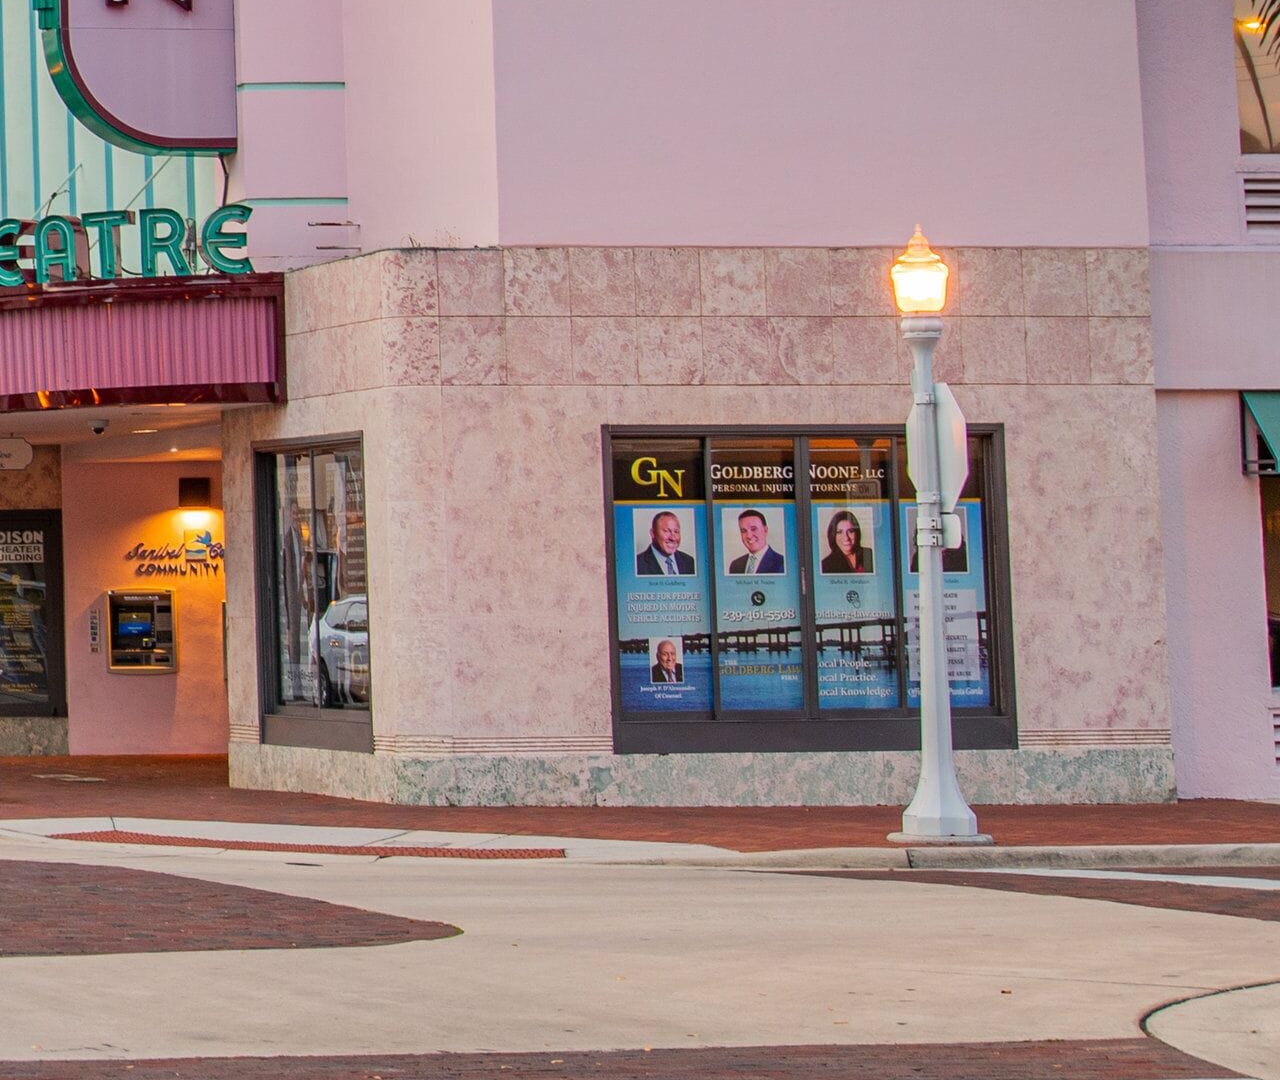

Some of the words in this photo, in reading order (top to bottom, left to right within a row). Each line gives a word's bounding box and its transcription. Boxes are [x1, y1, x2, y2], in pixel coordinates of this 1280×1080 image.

[711, 463, 793, 480] GOLDBERG
[866, 468, 885, 479] LLC
[712, 483, 761, 492] PERSONAL
[762, 483, 794, 493] INJURY
[809, 483, 858, 492] TTORNEYS
[135, 563, 219, 576] COMMUNITY
[627, 592, 656, 601] JUSTICE
[657, 592, 671, 600] FOR
[672, 592, 701, 600] PEOPLE
[628, 603, 658, 613] INJURED
[660, 603, 668, 611] IN
[668, 603, 696, 611] MOTOR
[628, 614, 659, 622] VEHICLE
[723, 608, 796, 621] 239-461-5508
[815, 608, 891, 619] oldberg-law.com
[778, 664, 800, 674] LAW
[819, 659, 837, 668] ocal
[840, 659, 872, 669] People.
[819, 673, 837, 682] ocal
[840, 673, 878, 682] Practice.
[819, 687, 838, 696] ocal
[840, 687, 894, 697] Knowledge.
